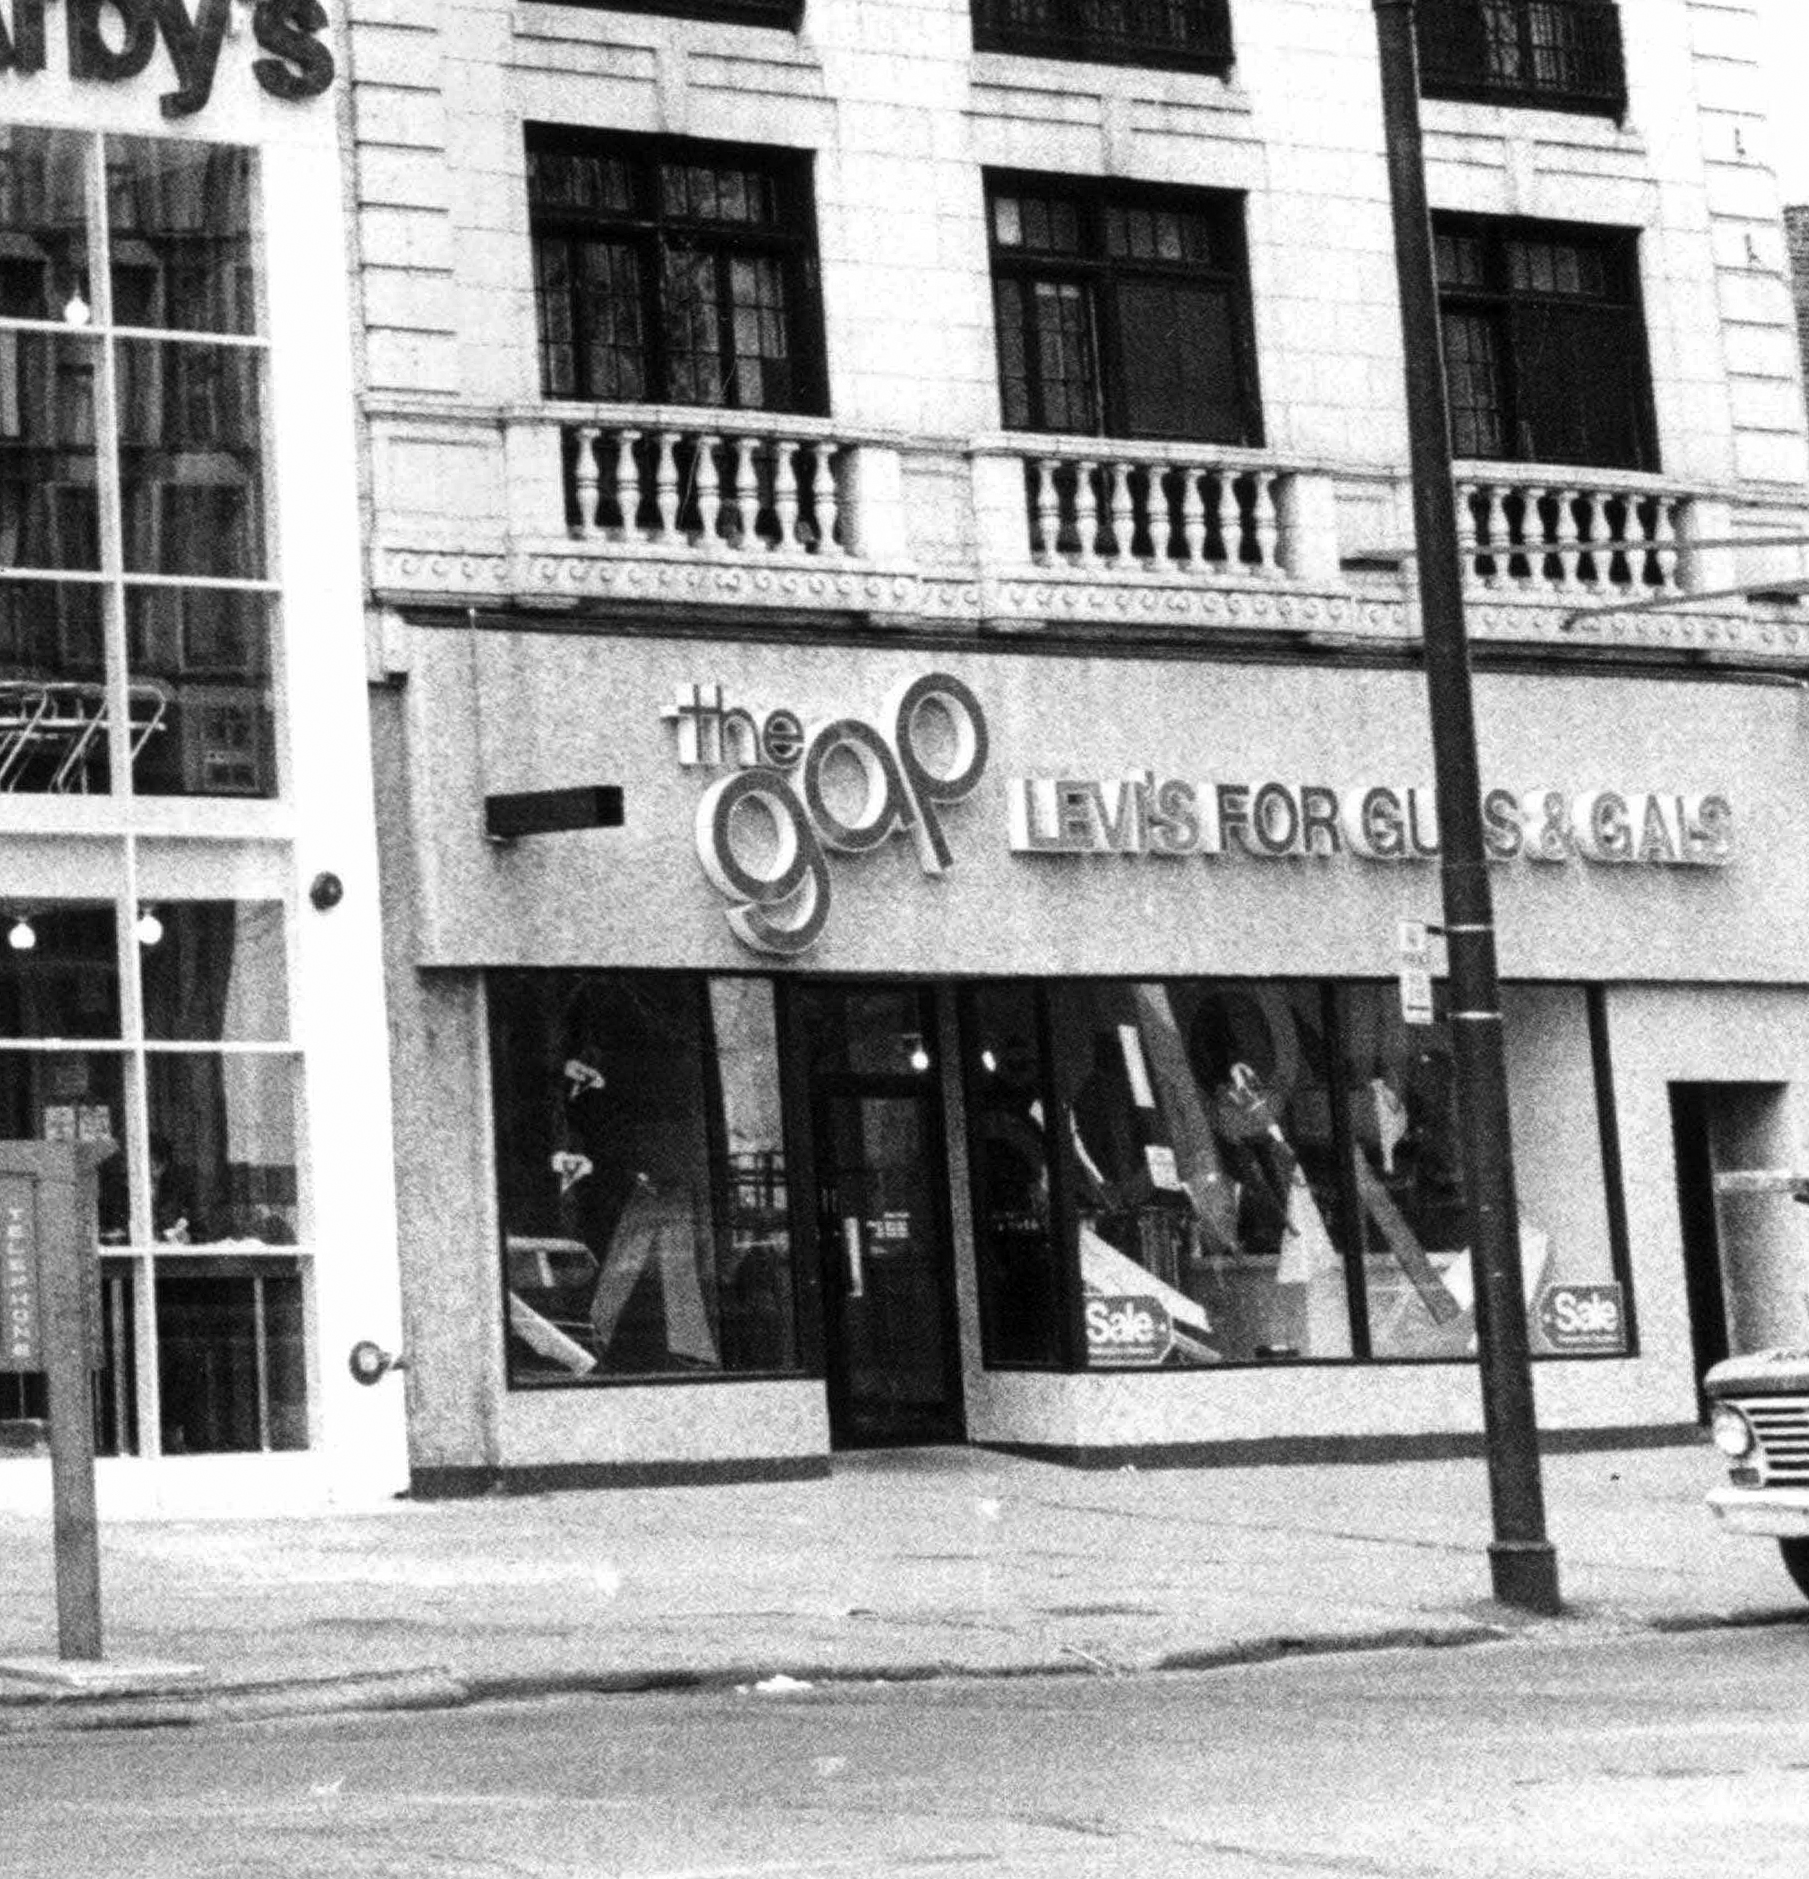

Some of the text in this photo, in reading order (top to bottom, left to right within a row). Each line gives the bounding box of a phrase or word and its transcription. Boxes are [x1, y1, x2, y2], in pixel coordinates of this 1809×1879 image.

[661, 682, 806, 769] the
[695, 671, 990, 955] gap
[1009, 768, 1734, 867] LEVI'S FOR GUS & GALS
[7, 1207, 32, 1358] TELEPHONE
[1085, 1301, 1156, 1344] Sale
[1554, 1291, 1618, 1333] Sale
